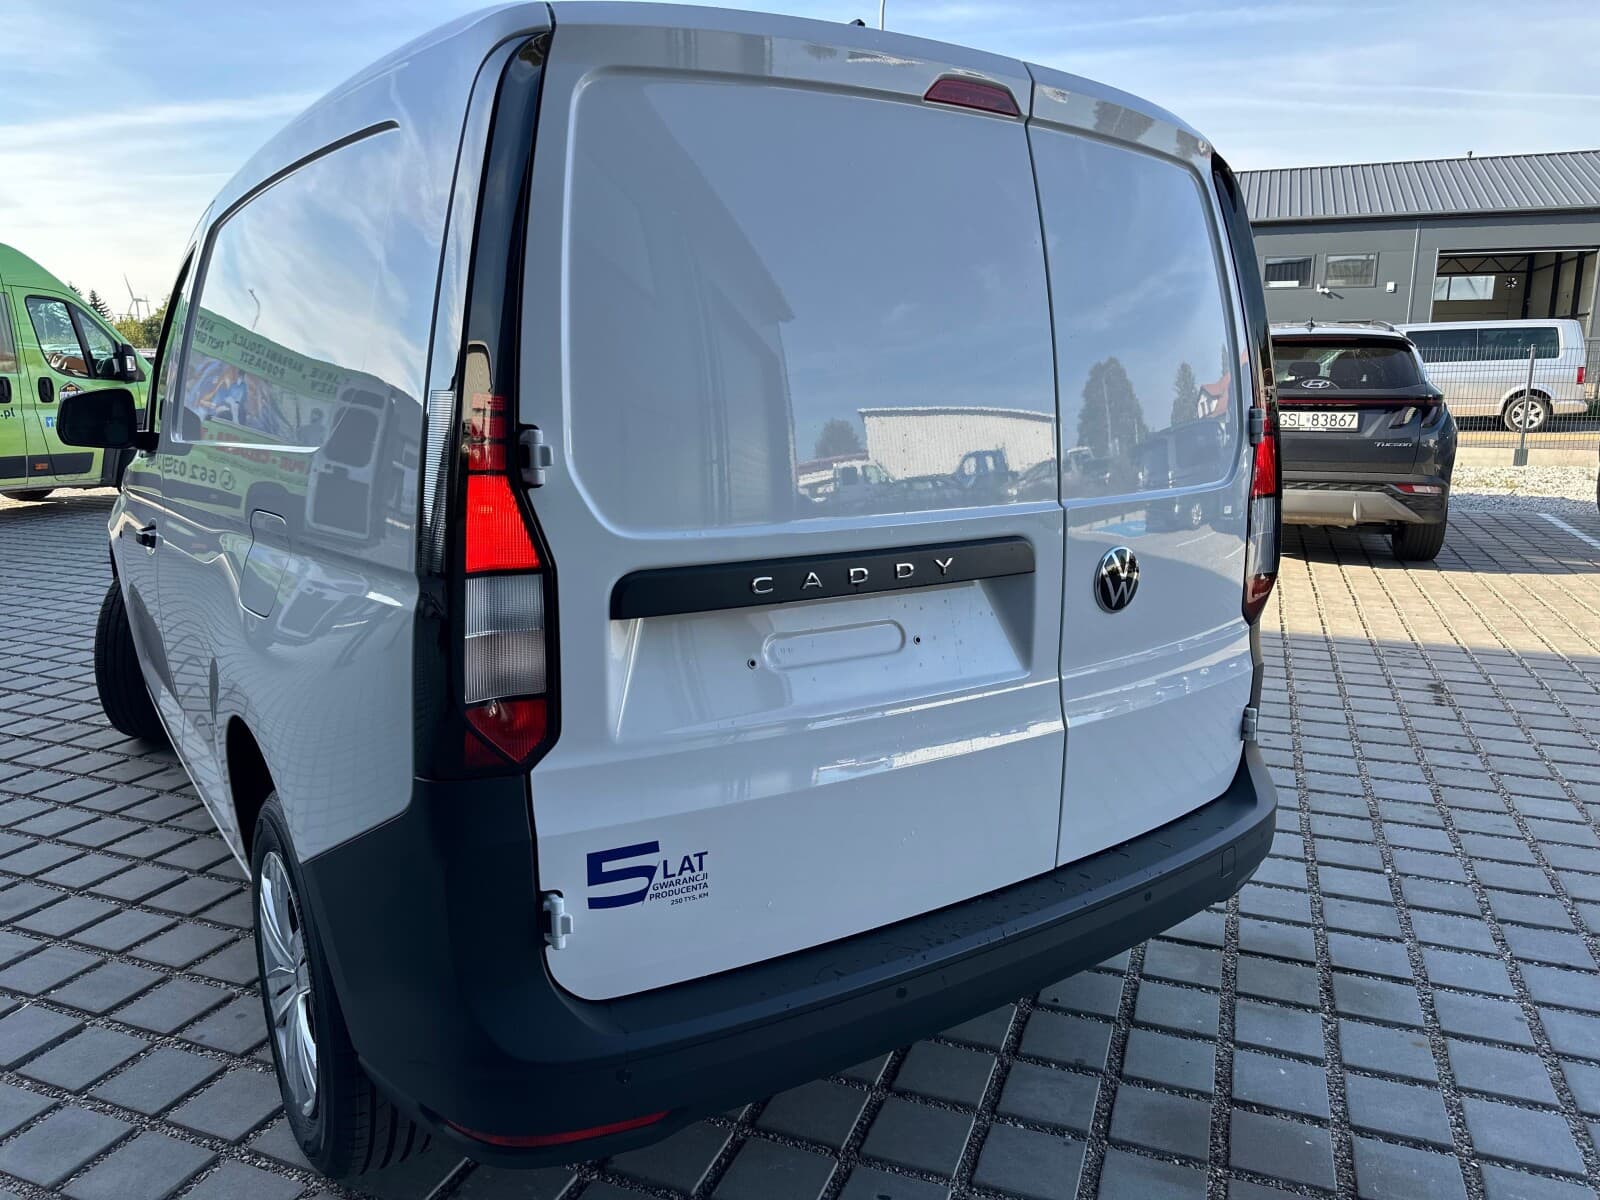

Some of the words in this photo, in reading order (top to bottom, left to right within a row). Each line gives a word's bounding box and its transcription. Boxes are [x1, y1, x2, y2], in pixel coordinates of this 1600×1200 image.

[1279, 413, 1305, 427] GSL
[1311, 413, 1356, 427] 83867
[751, 557, 954, 595] CADDY
[587, 840, 660, 910] 5
[662, 851, 709, 879] LAT
[652, 872, 708, 892] GWARANCJI
[649, 882, 709, 901] PRODUCENTA
[684, 895, 698, 903] TYS.
